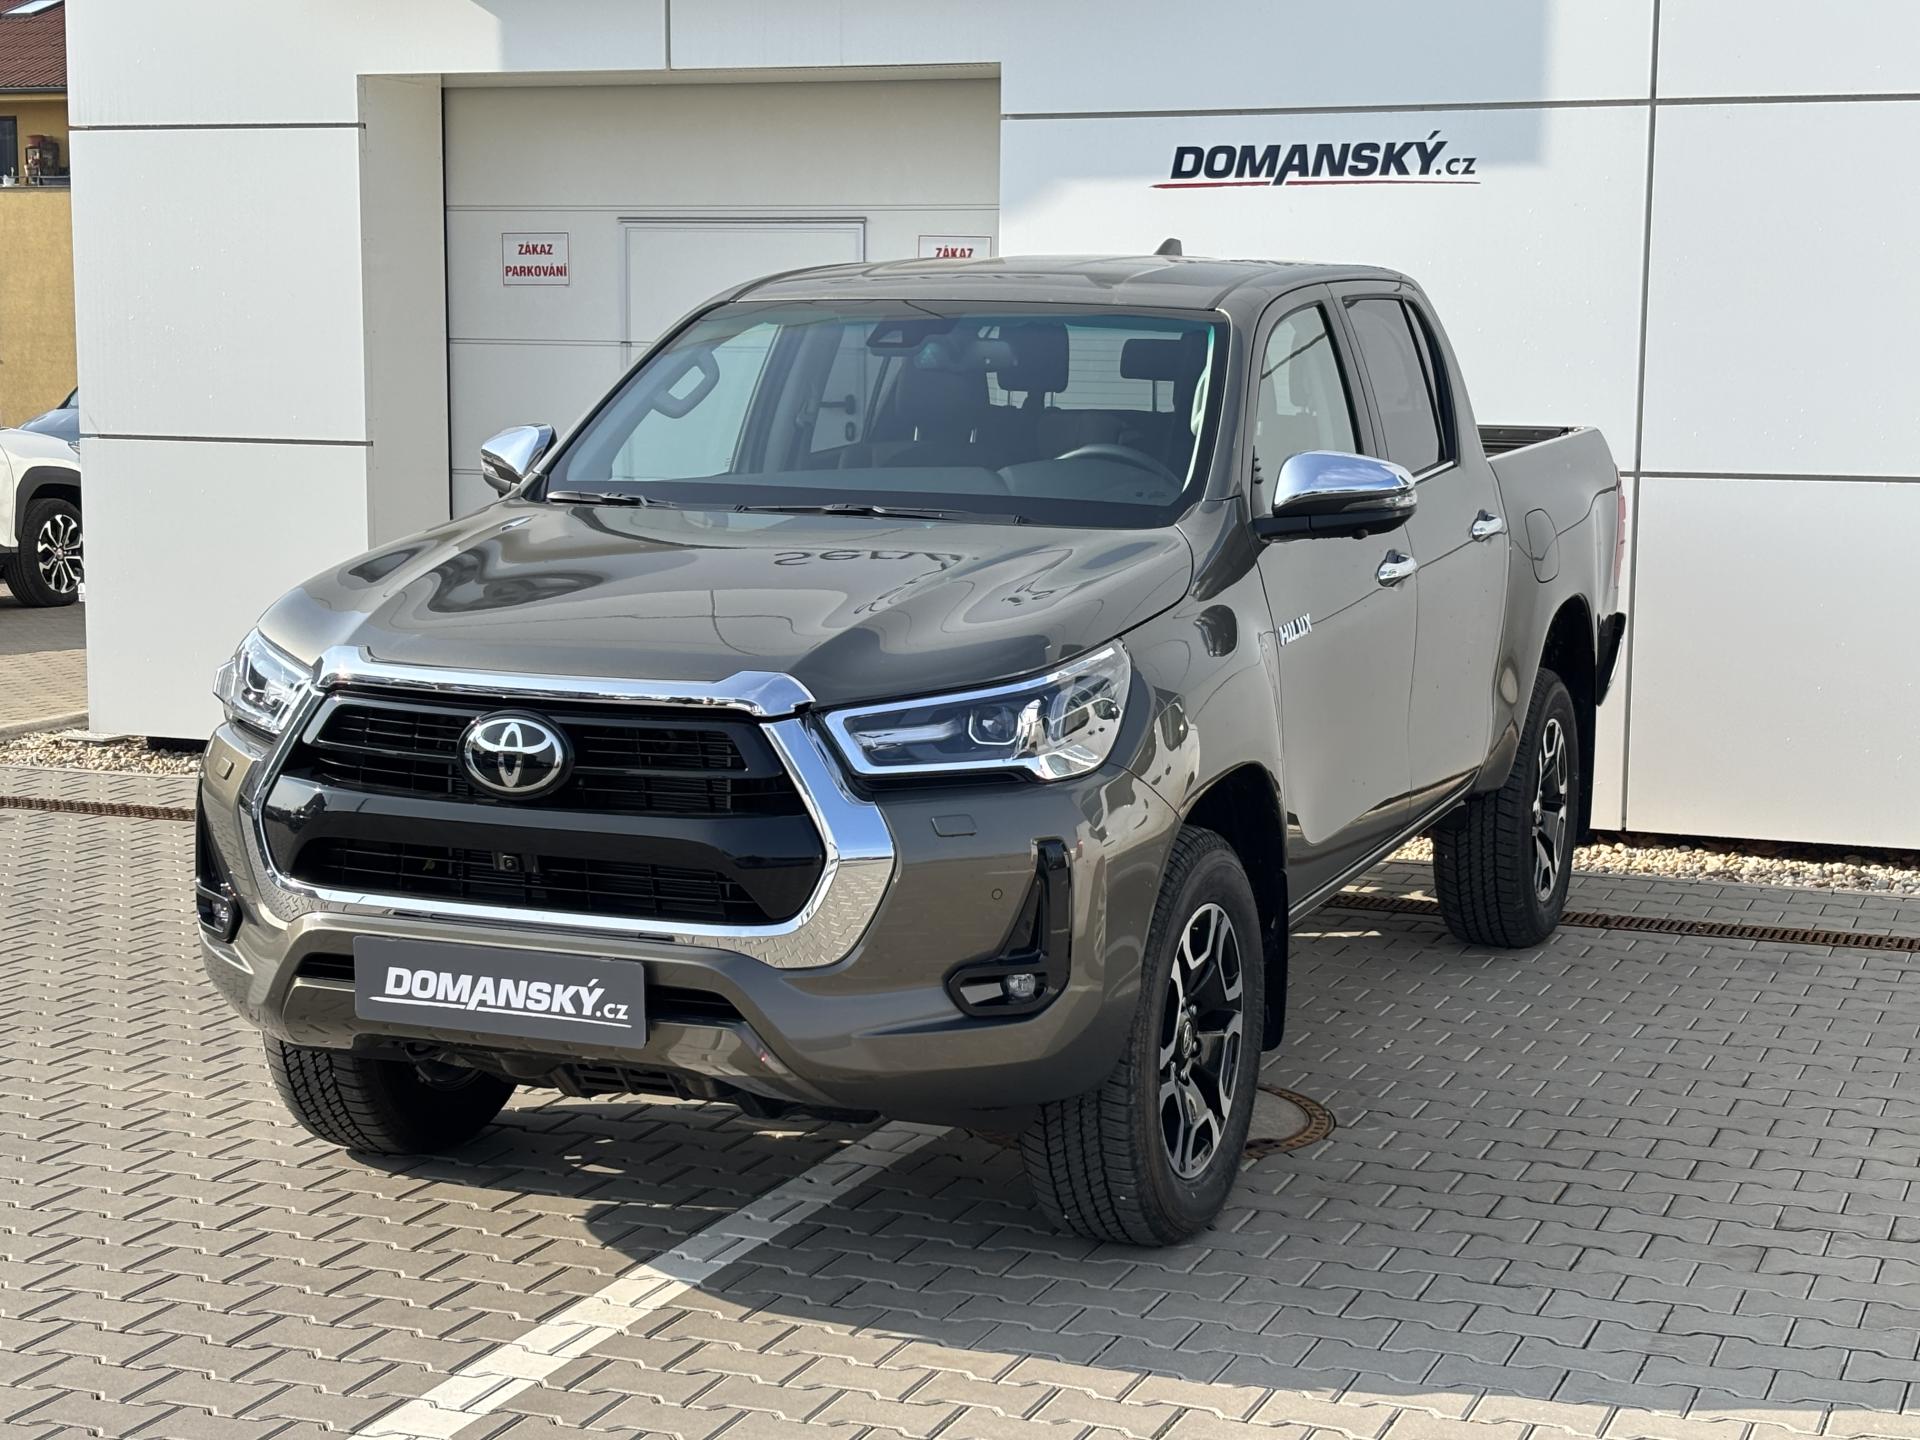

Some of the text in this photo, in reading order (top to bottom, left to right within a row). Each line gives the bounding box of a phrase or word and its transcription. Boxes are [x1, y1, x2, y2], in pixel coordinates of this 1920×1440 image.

[518, 241, 553, 255] ZÁKAZ
[505, 262, 567, 277] PARKOVÁNÍ
[1279, 613, 1312, 646] HILUX
